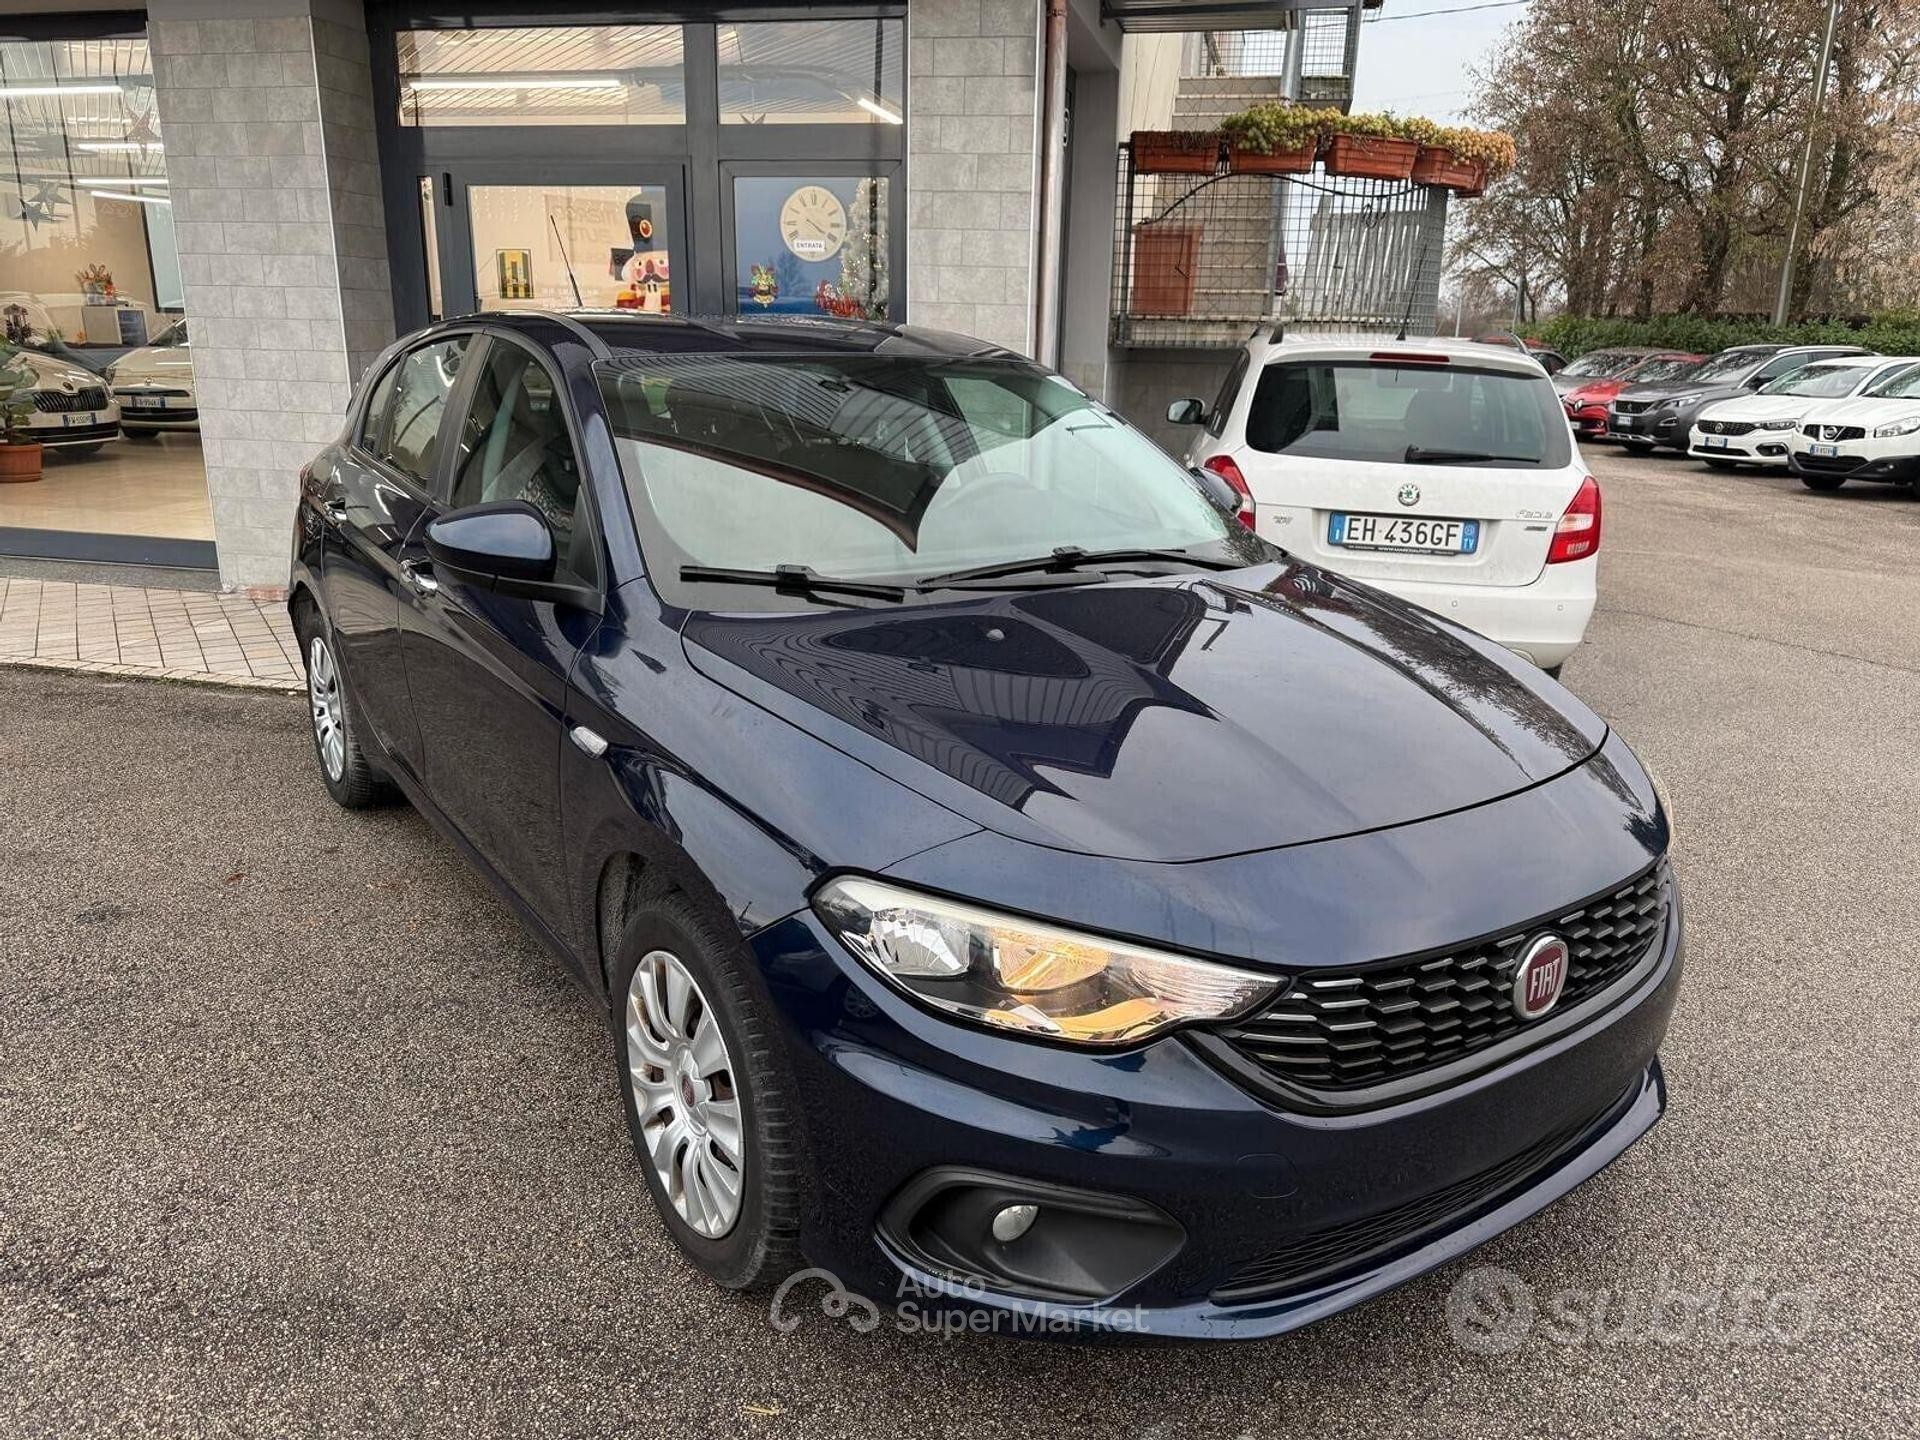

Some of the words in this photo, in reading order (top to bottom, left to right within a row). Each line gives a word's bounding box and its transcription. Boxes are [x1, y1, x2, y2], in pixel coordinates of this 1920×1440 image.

[1346, 517, 1377, 542] EH
[1384, 520, 1460, 546] 436GF
[1463, 536, 1475, 549] TV
[1528, 957, 1561, 1002] FIAT
